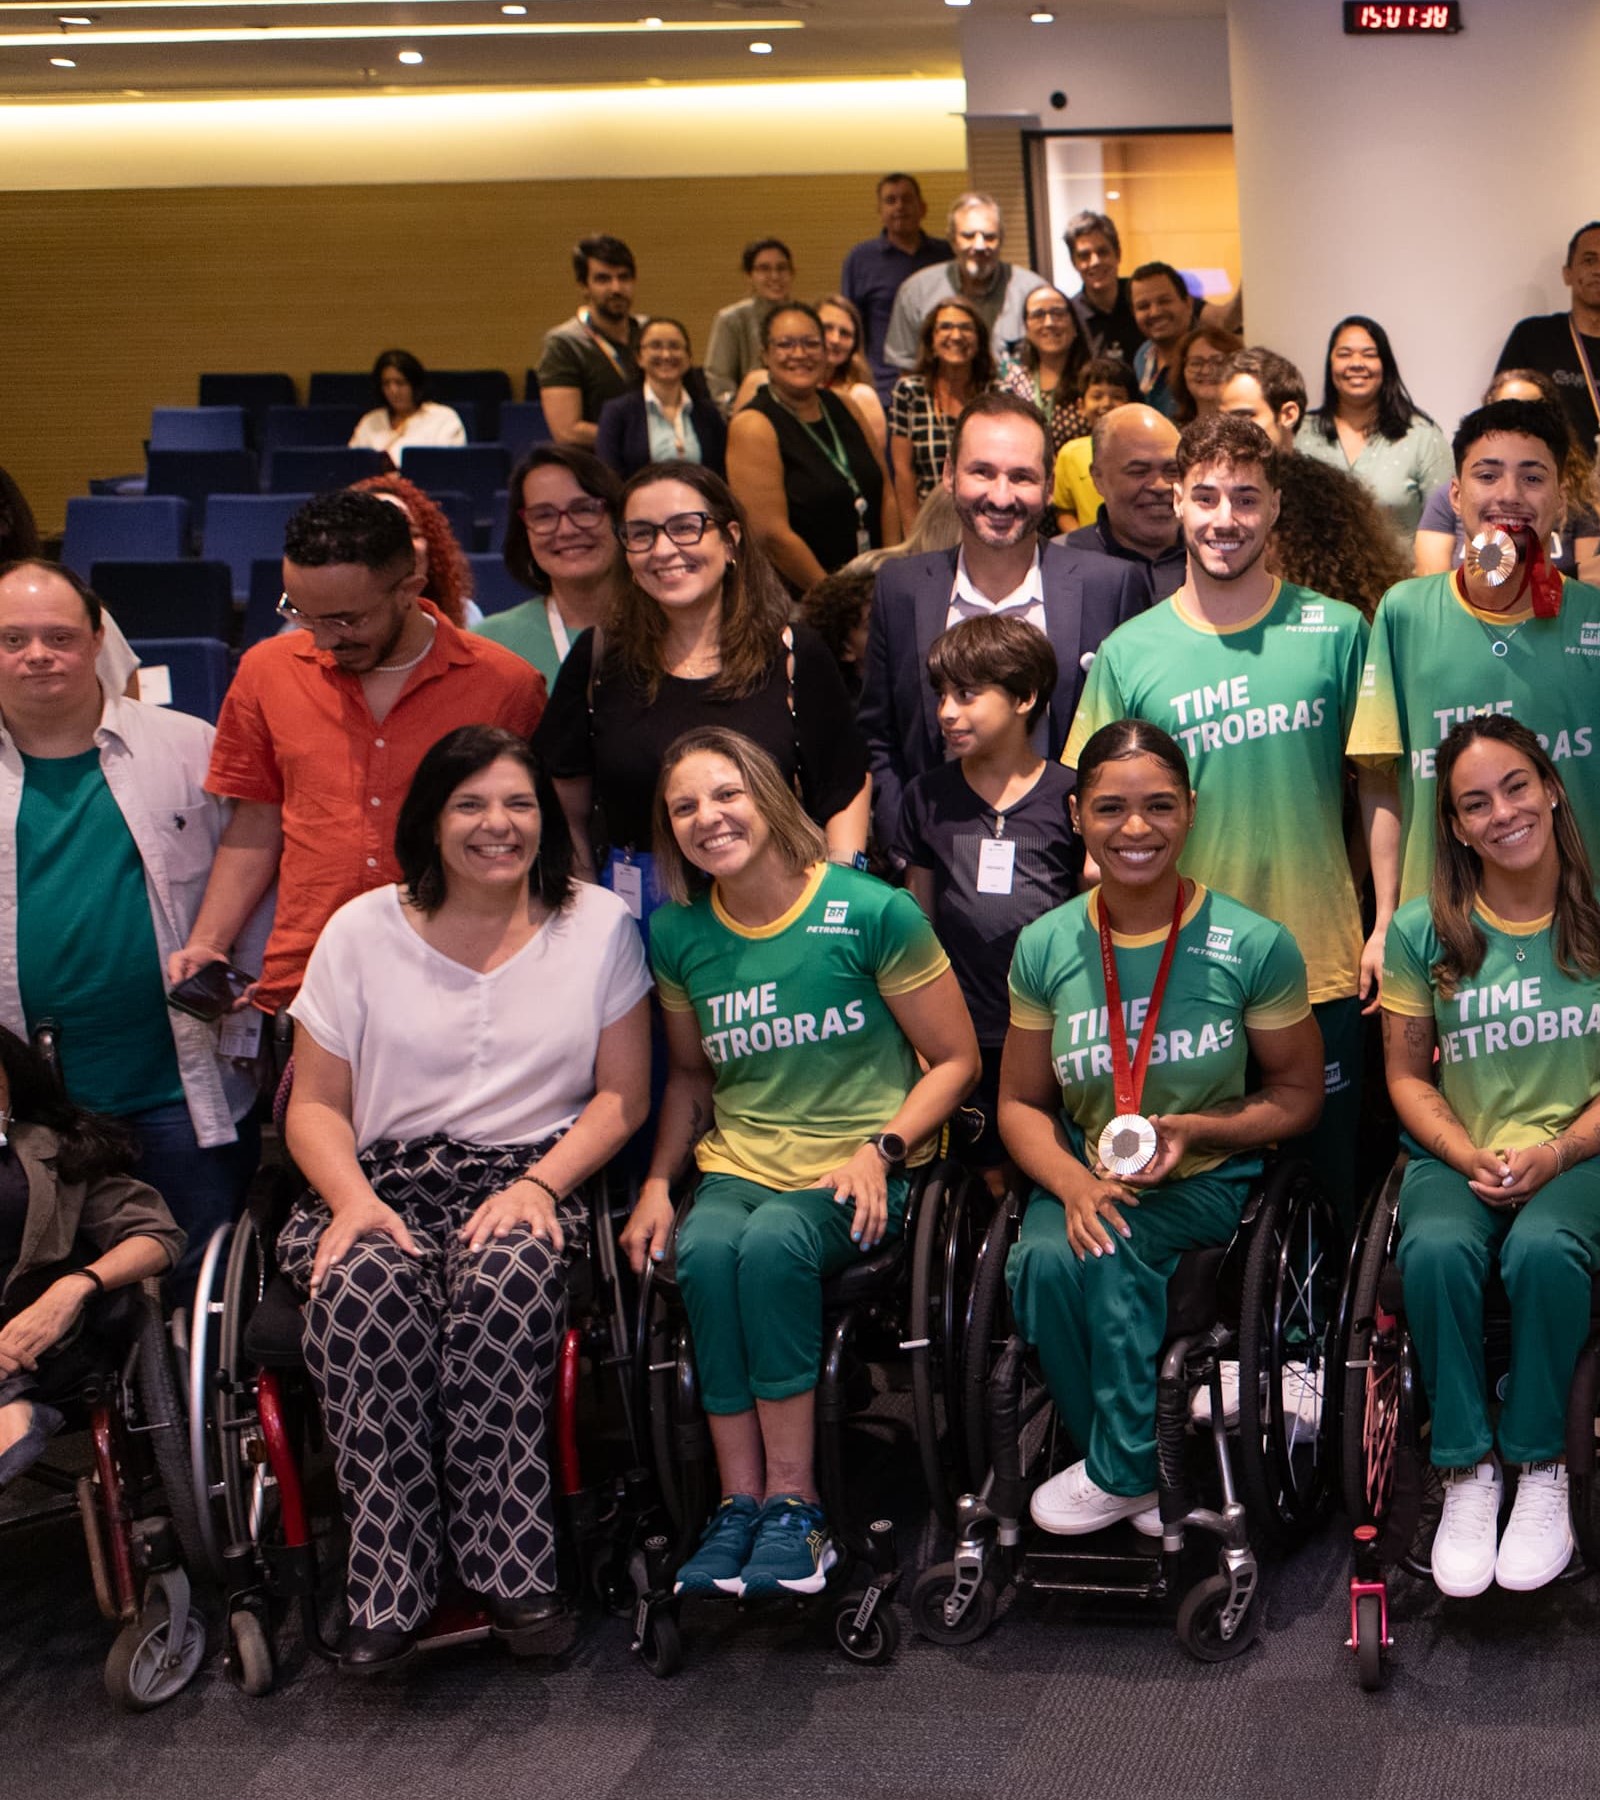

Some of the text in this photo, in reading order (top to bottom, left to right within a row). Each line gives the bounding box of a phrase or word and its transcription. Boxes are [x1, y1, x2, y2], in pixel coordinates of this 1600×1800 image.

[1169, 674, 1250, 726] TIME
[806, 925, 860, 936] PETROBRAS
[1186, 945, 1242, 965] PETROBRAS
[707, 981, 778, 1028] TIME
[1453, 976, 1543, 1023] TIME
[857, 1588, 877, 1627] JUMPER
